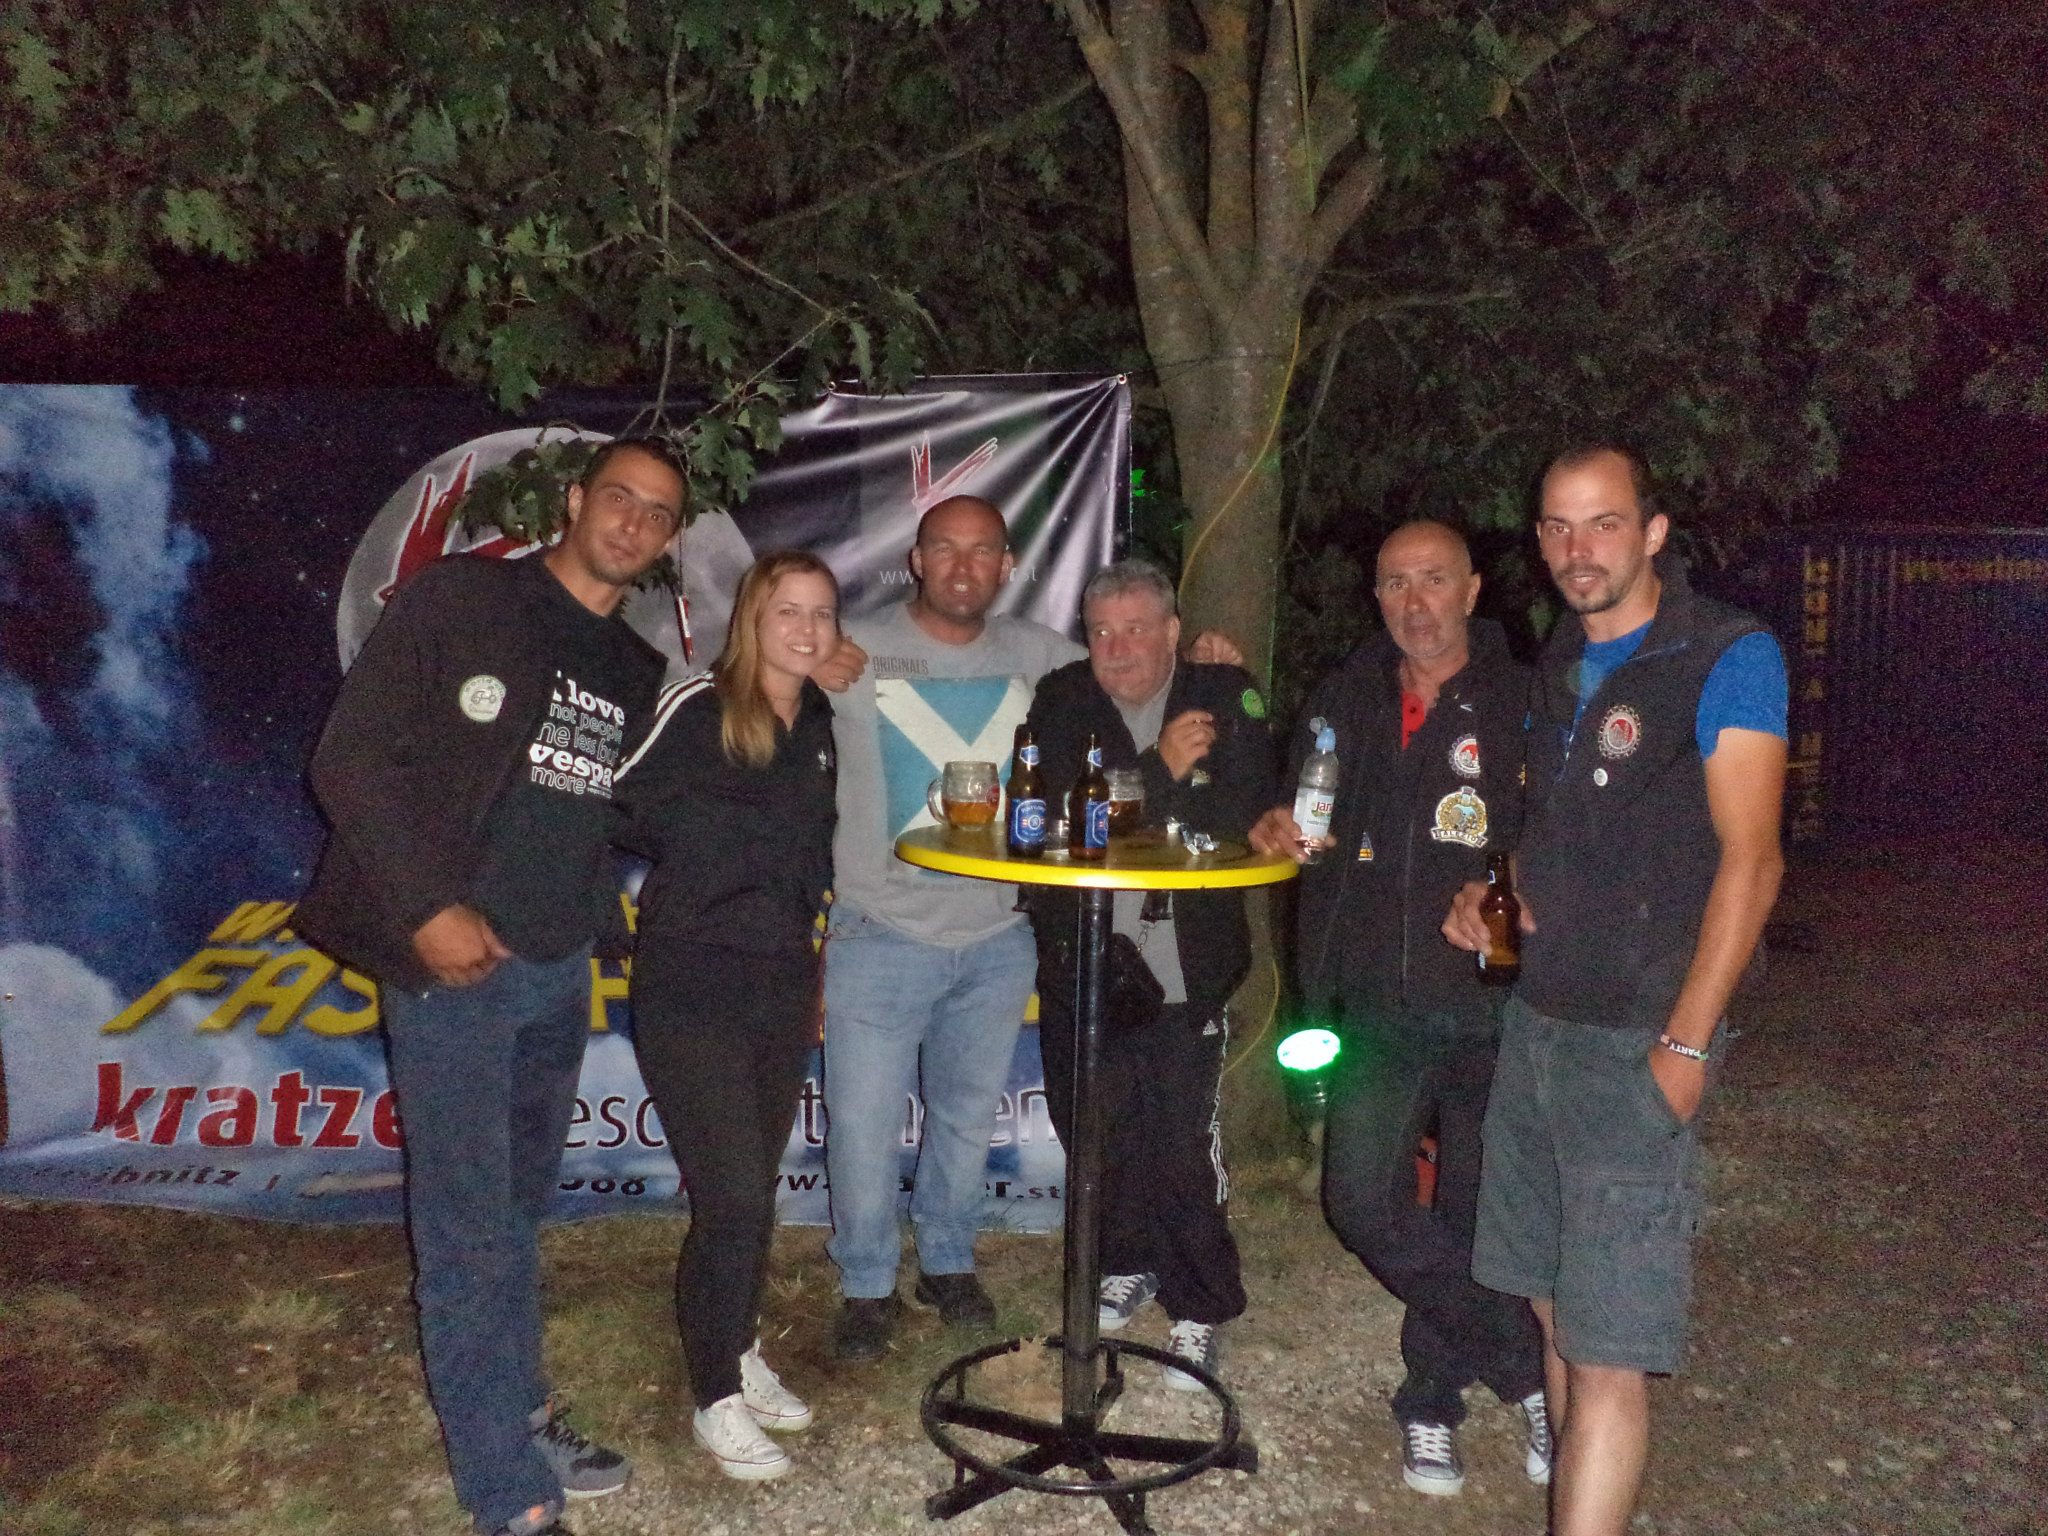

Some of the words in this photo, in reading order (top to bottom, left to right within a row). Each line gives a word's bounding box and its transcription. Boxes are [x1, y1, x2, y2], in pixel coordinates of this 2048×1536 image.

[872, 656, 929, 674] ORIGINALS
[549, 702, 577, 724] not
[567, 678, 625, 726] love
[574, 726, 598, 756] less
[528, 743, 613, 788] vespa
[531, 765, 587, 795] more
[1669, 1041, 1701, 1058] PARTY
[90, 1061, 405, 1149] kratze
